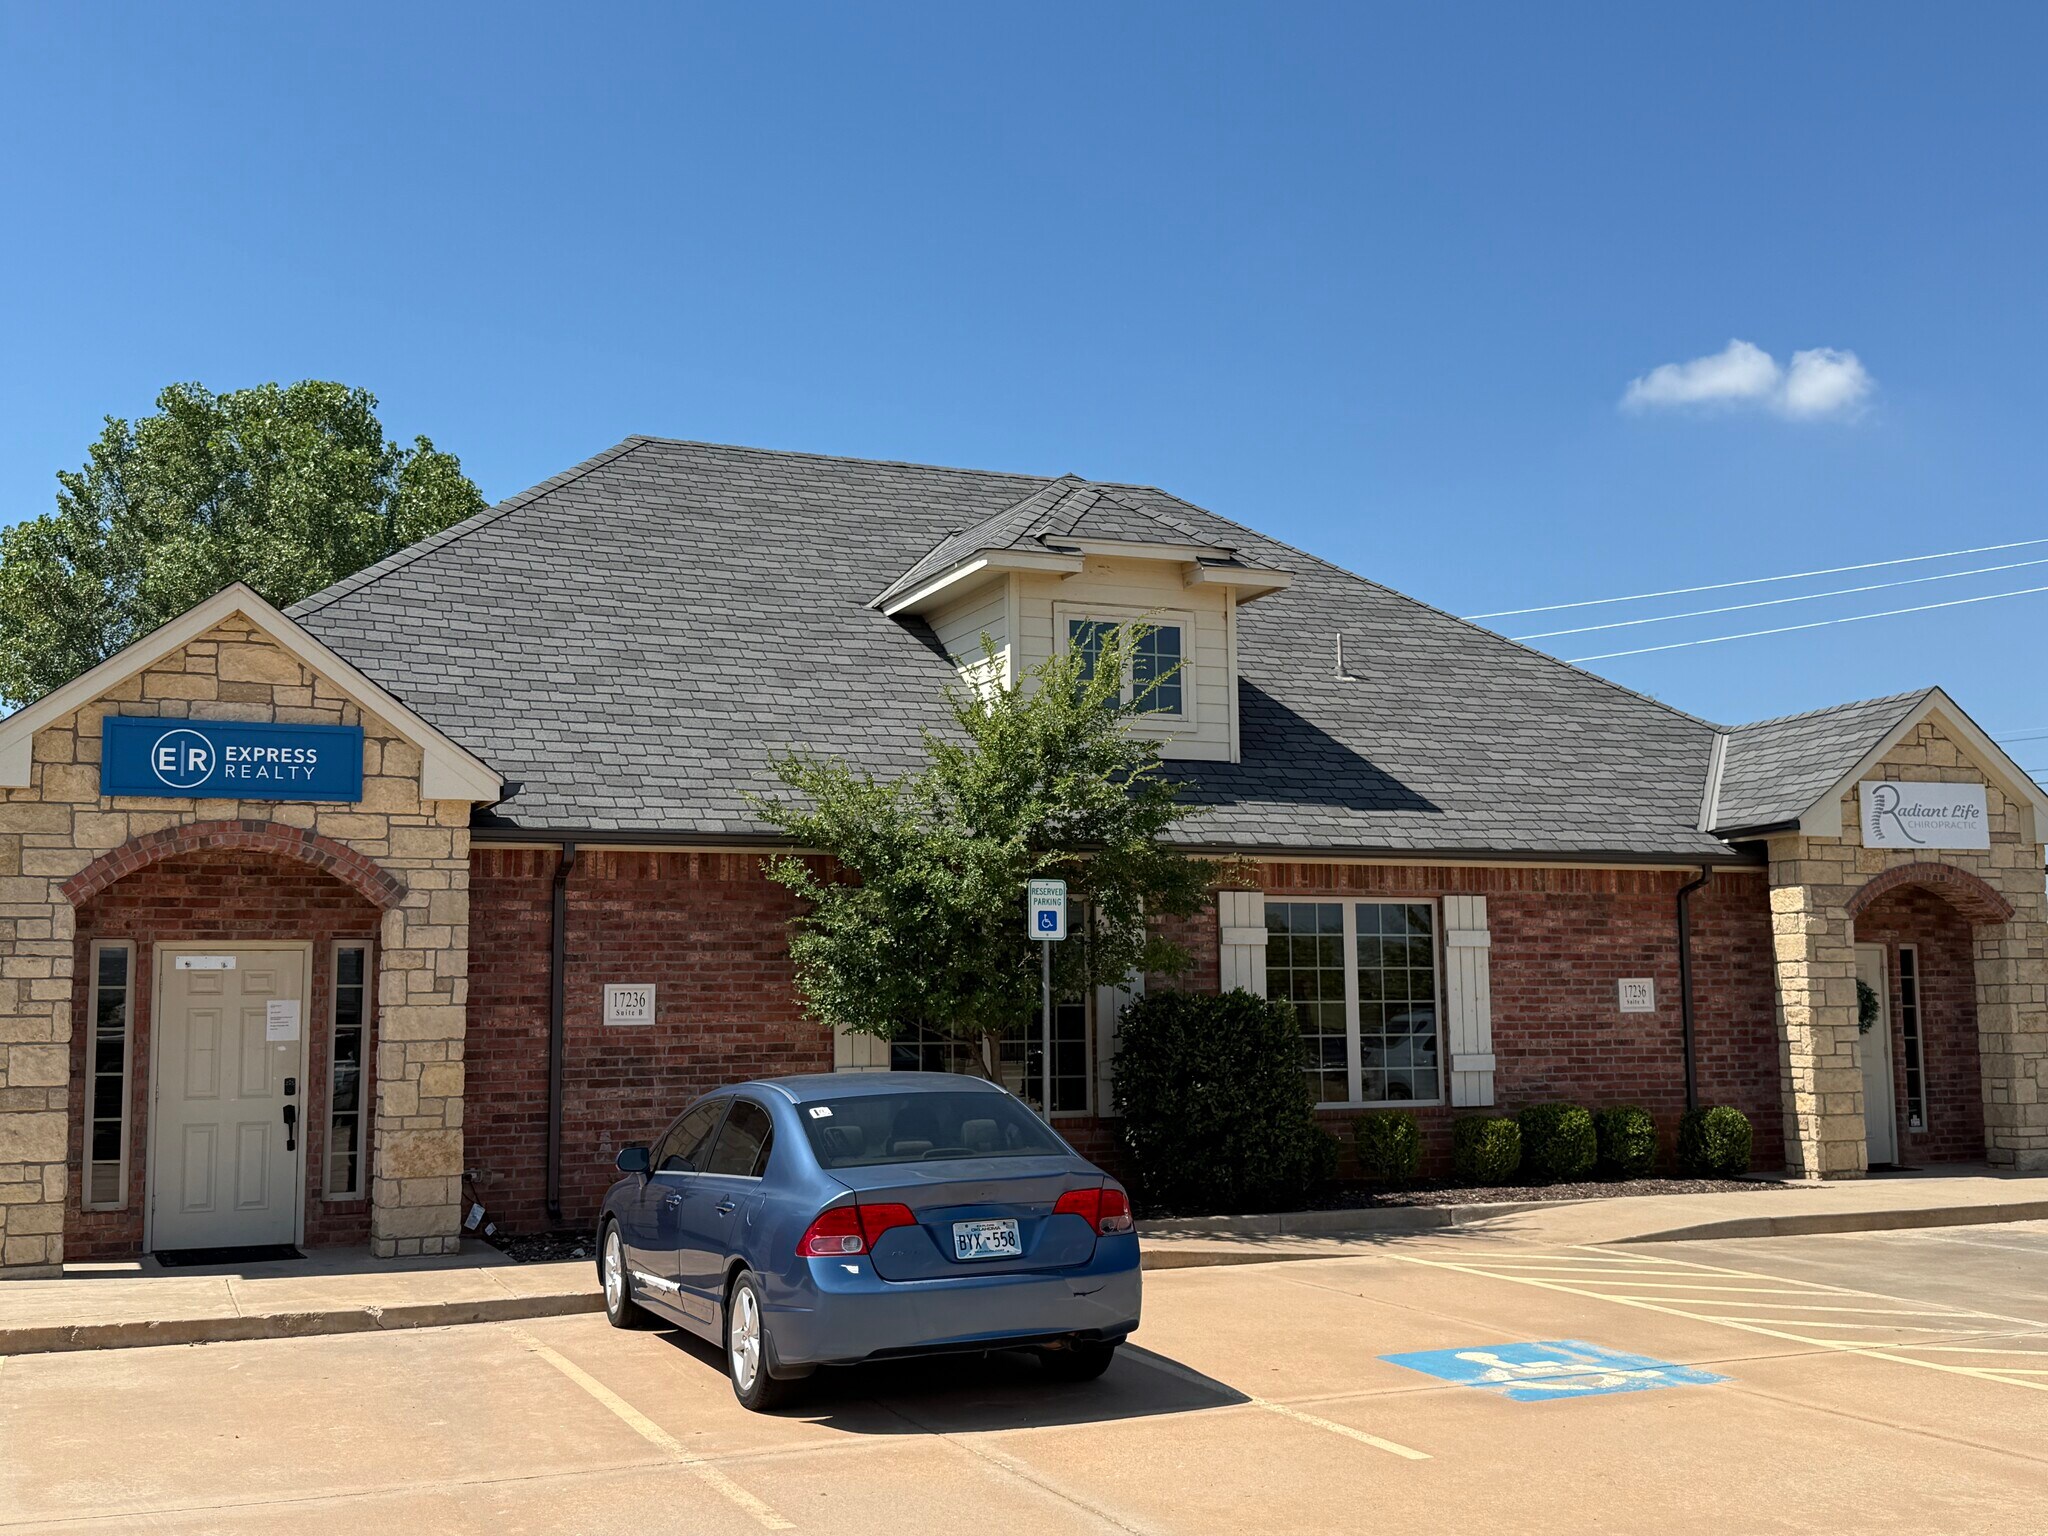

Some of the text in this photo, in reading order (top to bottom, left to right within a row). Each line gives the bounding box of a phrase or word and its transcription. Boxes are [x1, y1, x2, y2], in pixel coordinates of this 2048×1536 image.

[225, 746, 318, 764] EXPRESS
[224, 764, 316, 781] REALTY
[1951, 804, 1980, 821] Life
[1908, 820, 1977, 830] CHIROPRACTIC
[1031, 887, 1064, 896] RESERVED
[1033, 897, 1062, 906] PARKING
[1624, 984, 1647, 998] 17236
[613, 991, 646, 1008] 17236
[638, 1008, 643, 1016] B
